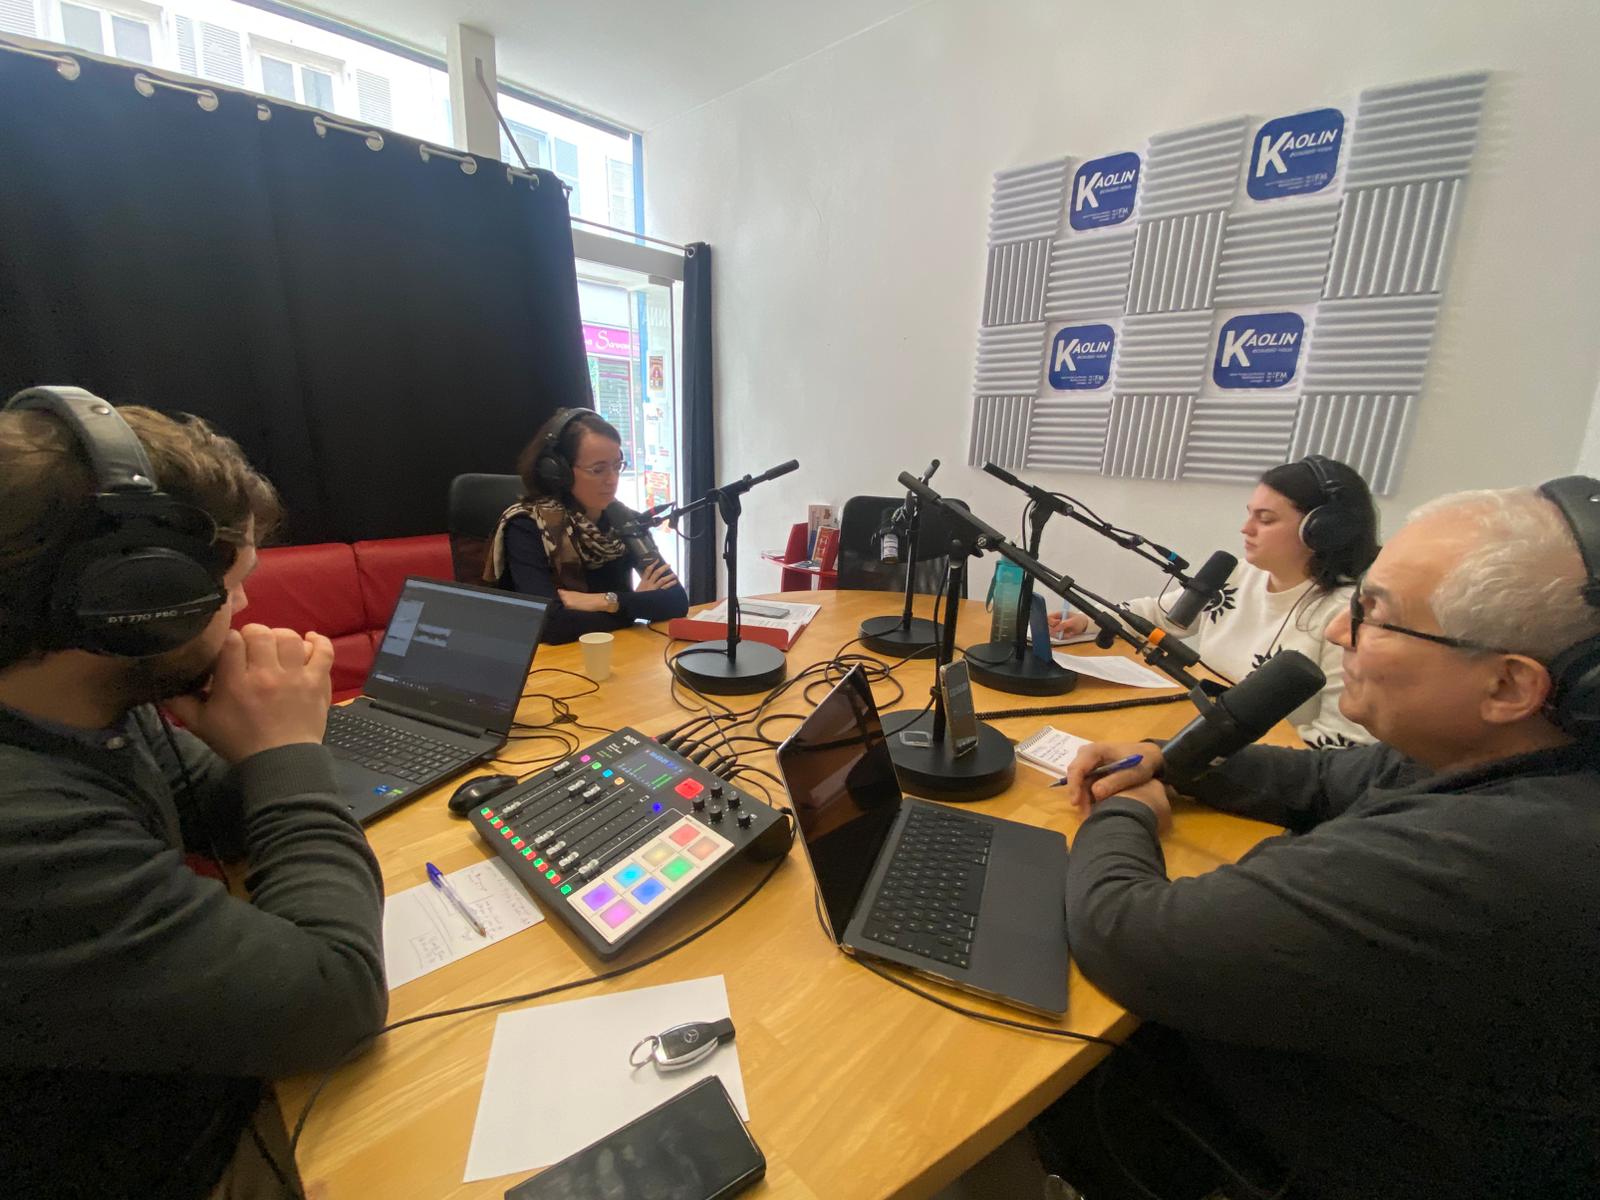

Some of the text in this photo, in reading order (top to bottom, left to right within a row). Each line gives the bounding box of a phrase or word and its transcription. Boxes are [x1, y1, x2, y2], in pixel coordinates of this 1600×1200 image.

[1256, 129, 1338, 177] KAOLIN
[1076, 169, 1136, 212] KAOLIN
[1054, 339, 1110, 372] KAOLIN
[1221, 329, 1298, 367] KAOLIN
